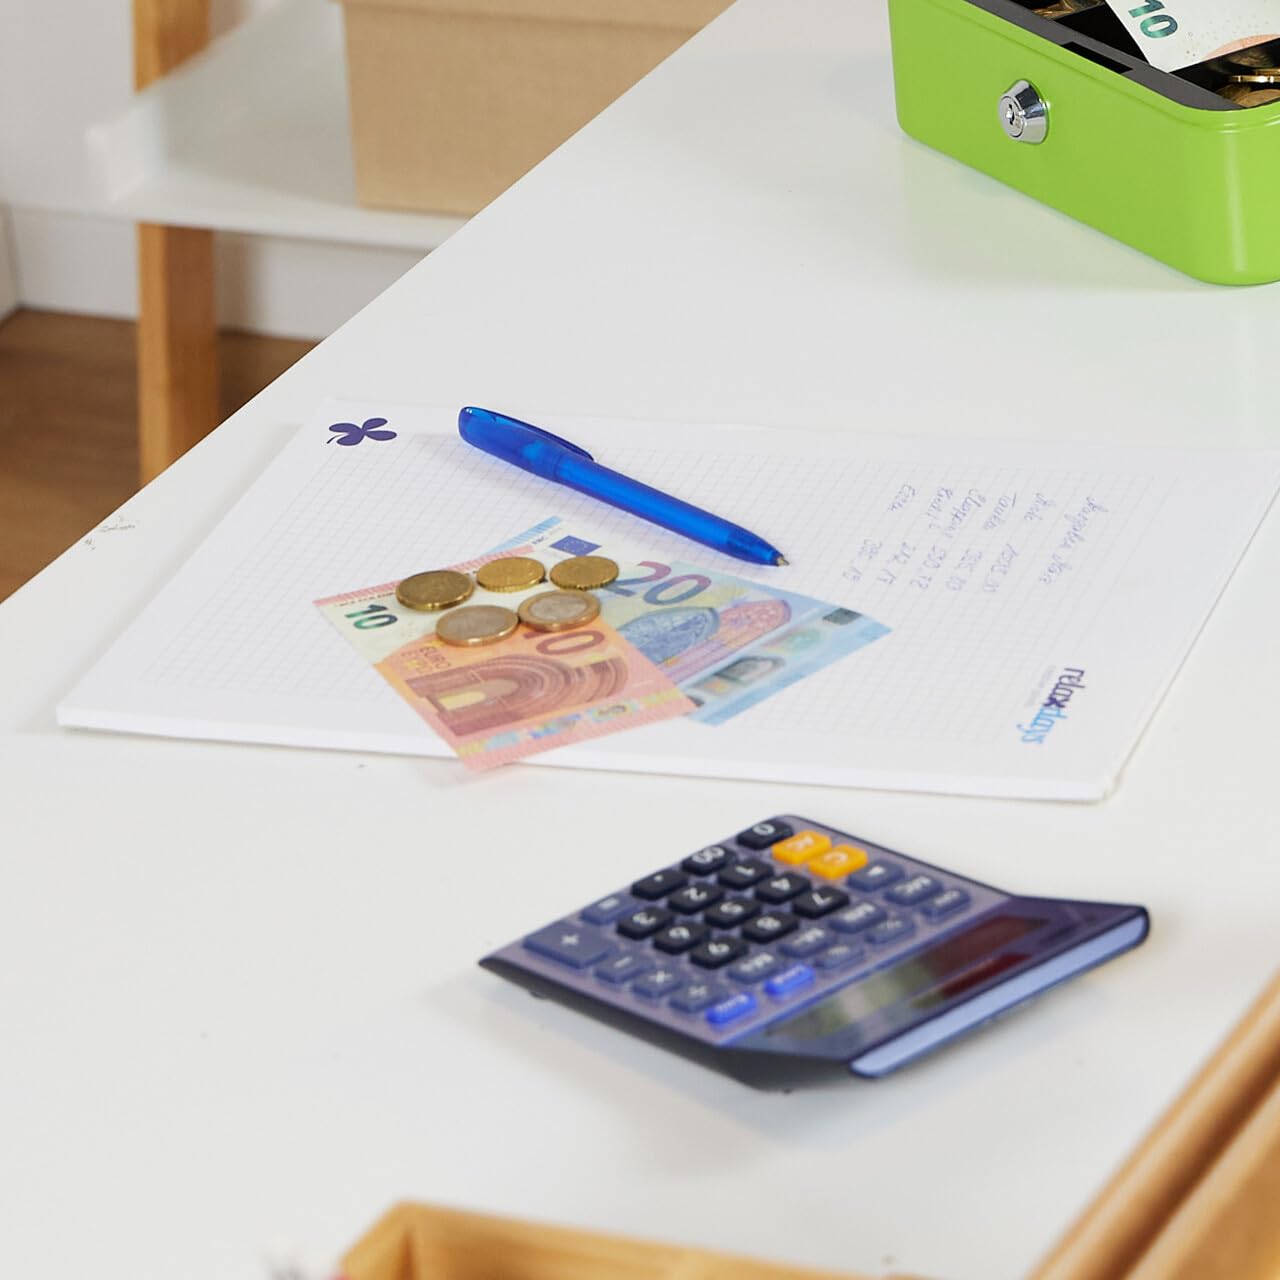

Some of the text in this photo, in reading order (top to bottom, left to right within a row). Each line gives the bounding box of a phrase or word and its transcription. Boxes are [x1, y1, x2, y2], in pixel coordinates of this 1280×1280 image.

[604, 560, 712, 606] 20
[344, 604, 398, 630] 10
[1016, 667, 1086, 745] relaxdays
[770, 877, 791, 891] 4
[682, 886, 708, 901] 2
[811, 893, 833, 906] 7
[756, 917, 782, 930] 8
[668, 926, 691, 940] 6
[708, 942, 731, 955] 9
